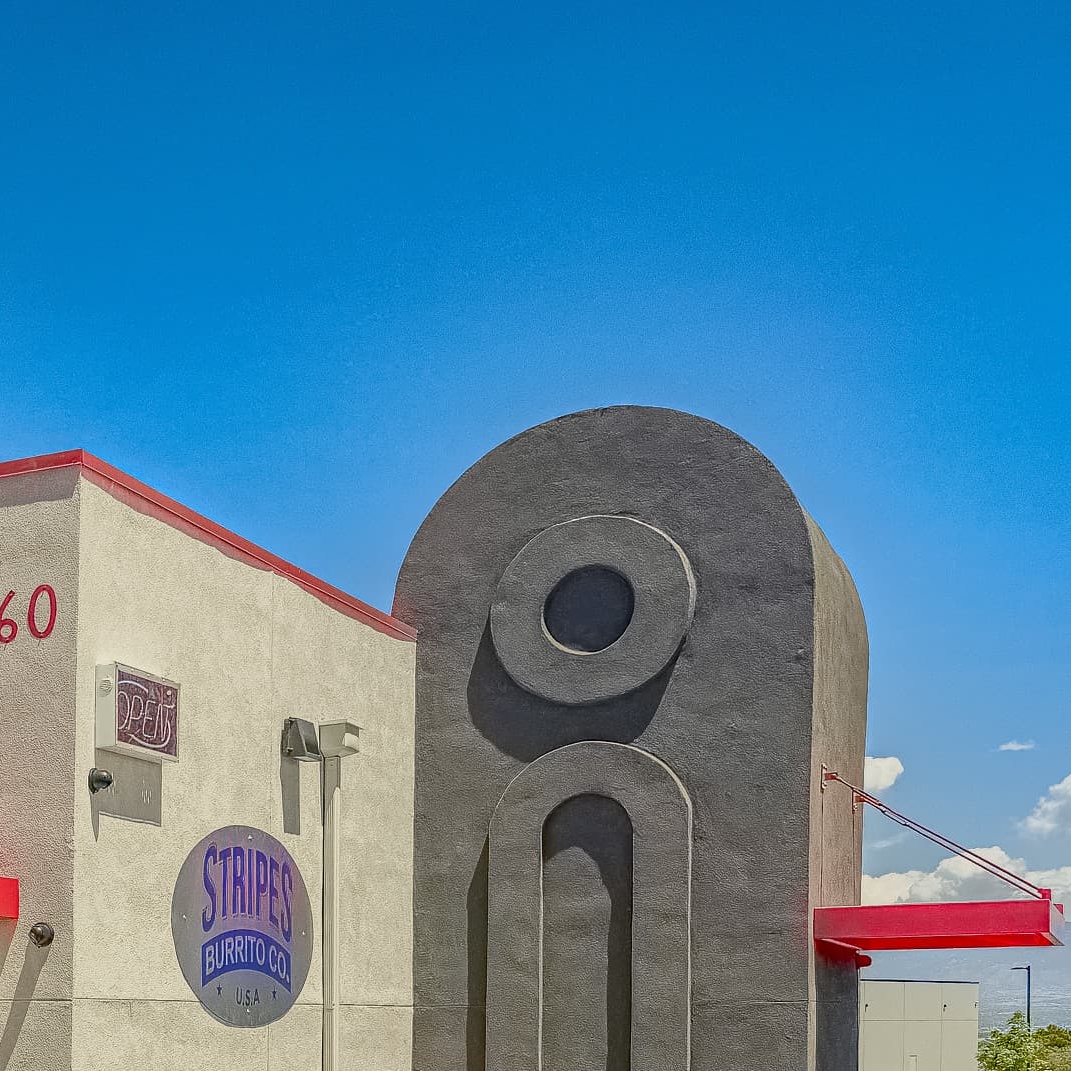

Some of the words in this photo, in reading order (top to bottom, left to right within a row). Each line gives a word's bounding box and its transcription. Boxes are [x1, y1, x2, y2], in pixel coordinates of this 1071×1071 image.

[202, 841, 293, 943] STRIPES
[205, 935, 266, 978] BURRITO
[269, 945, 290, 983] CO.
[236, 987, 261, 1007] U.S.A
